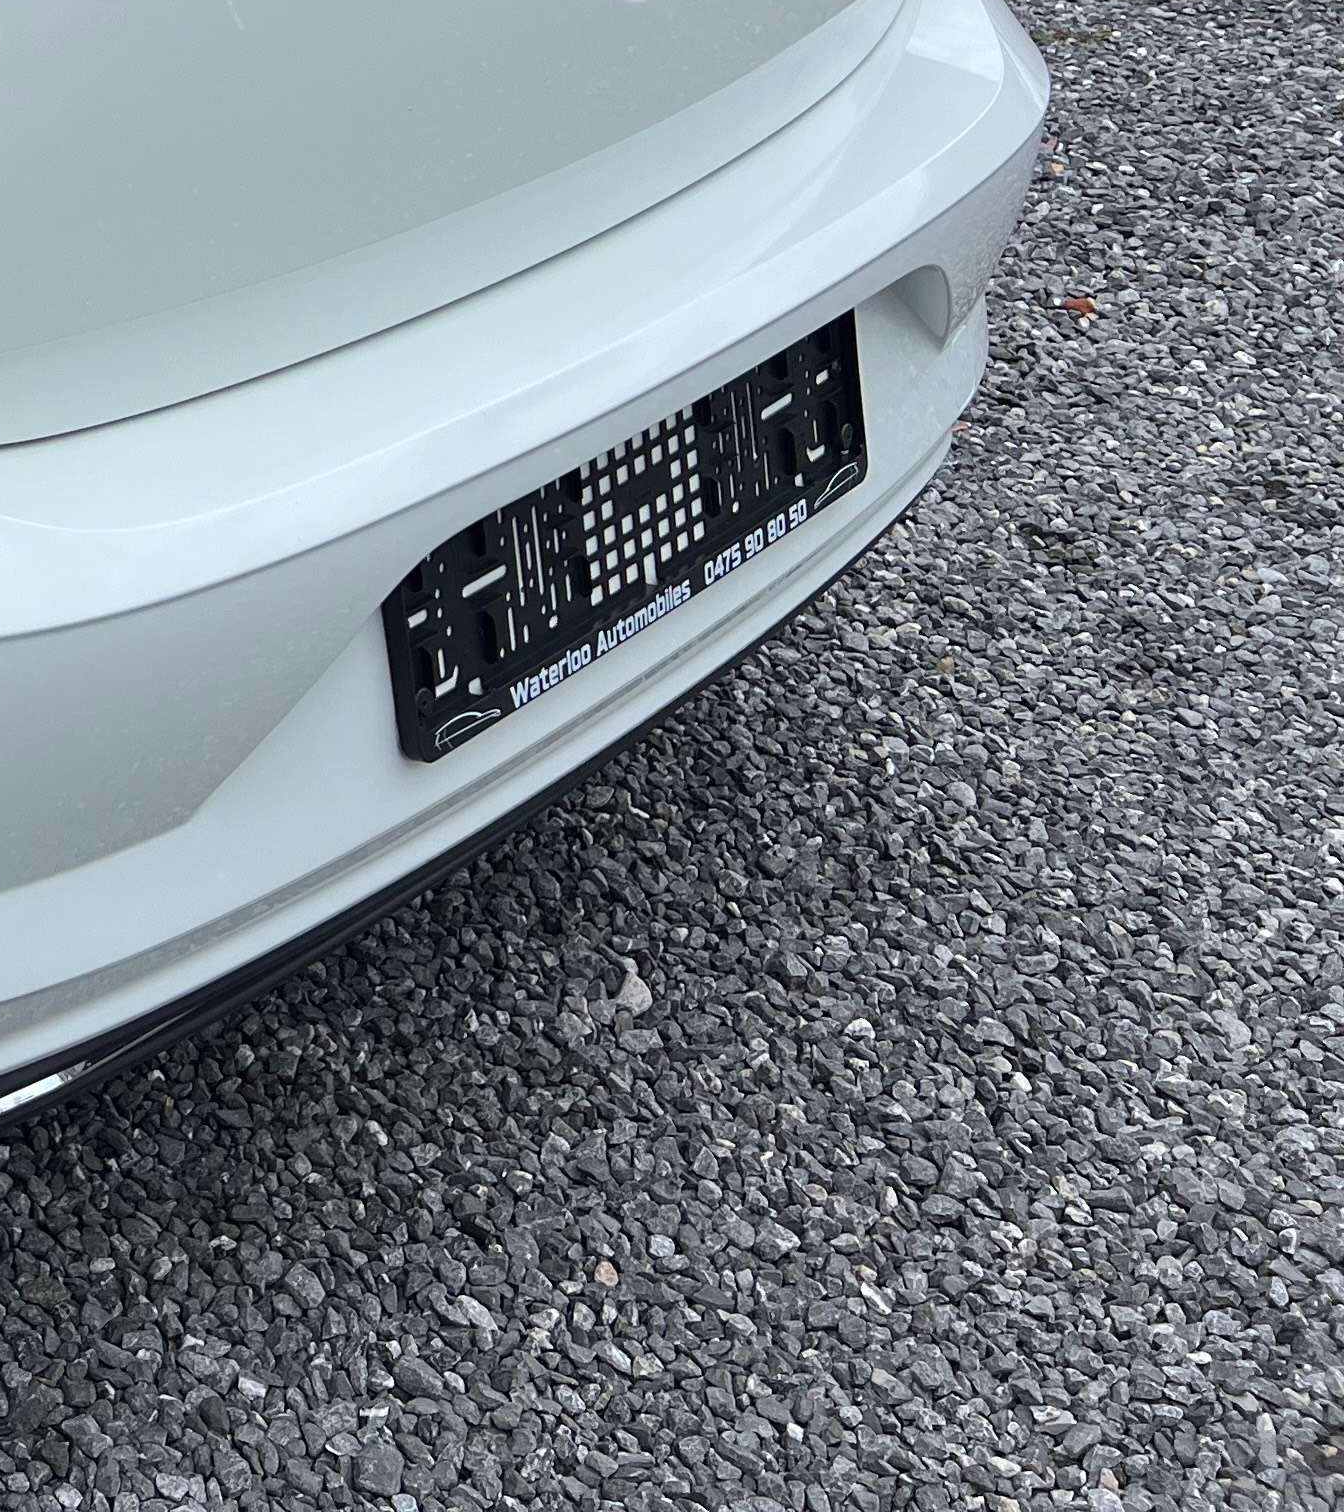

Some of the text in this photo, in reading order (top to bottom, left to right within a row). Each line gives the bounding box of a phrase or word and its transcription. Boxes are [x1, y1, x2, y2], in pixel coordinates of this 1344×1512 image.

[510, 498, 808, 709] Waterloo Automobiles 0475 90 80 50
